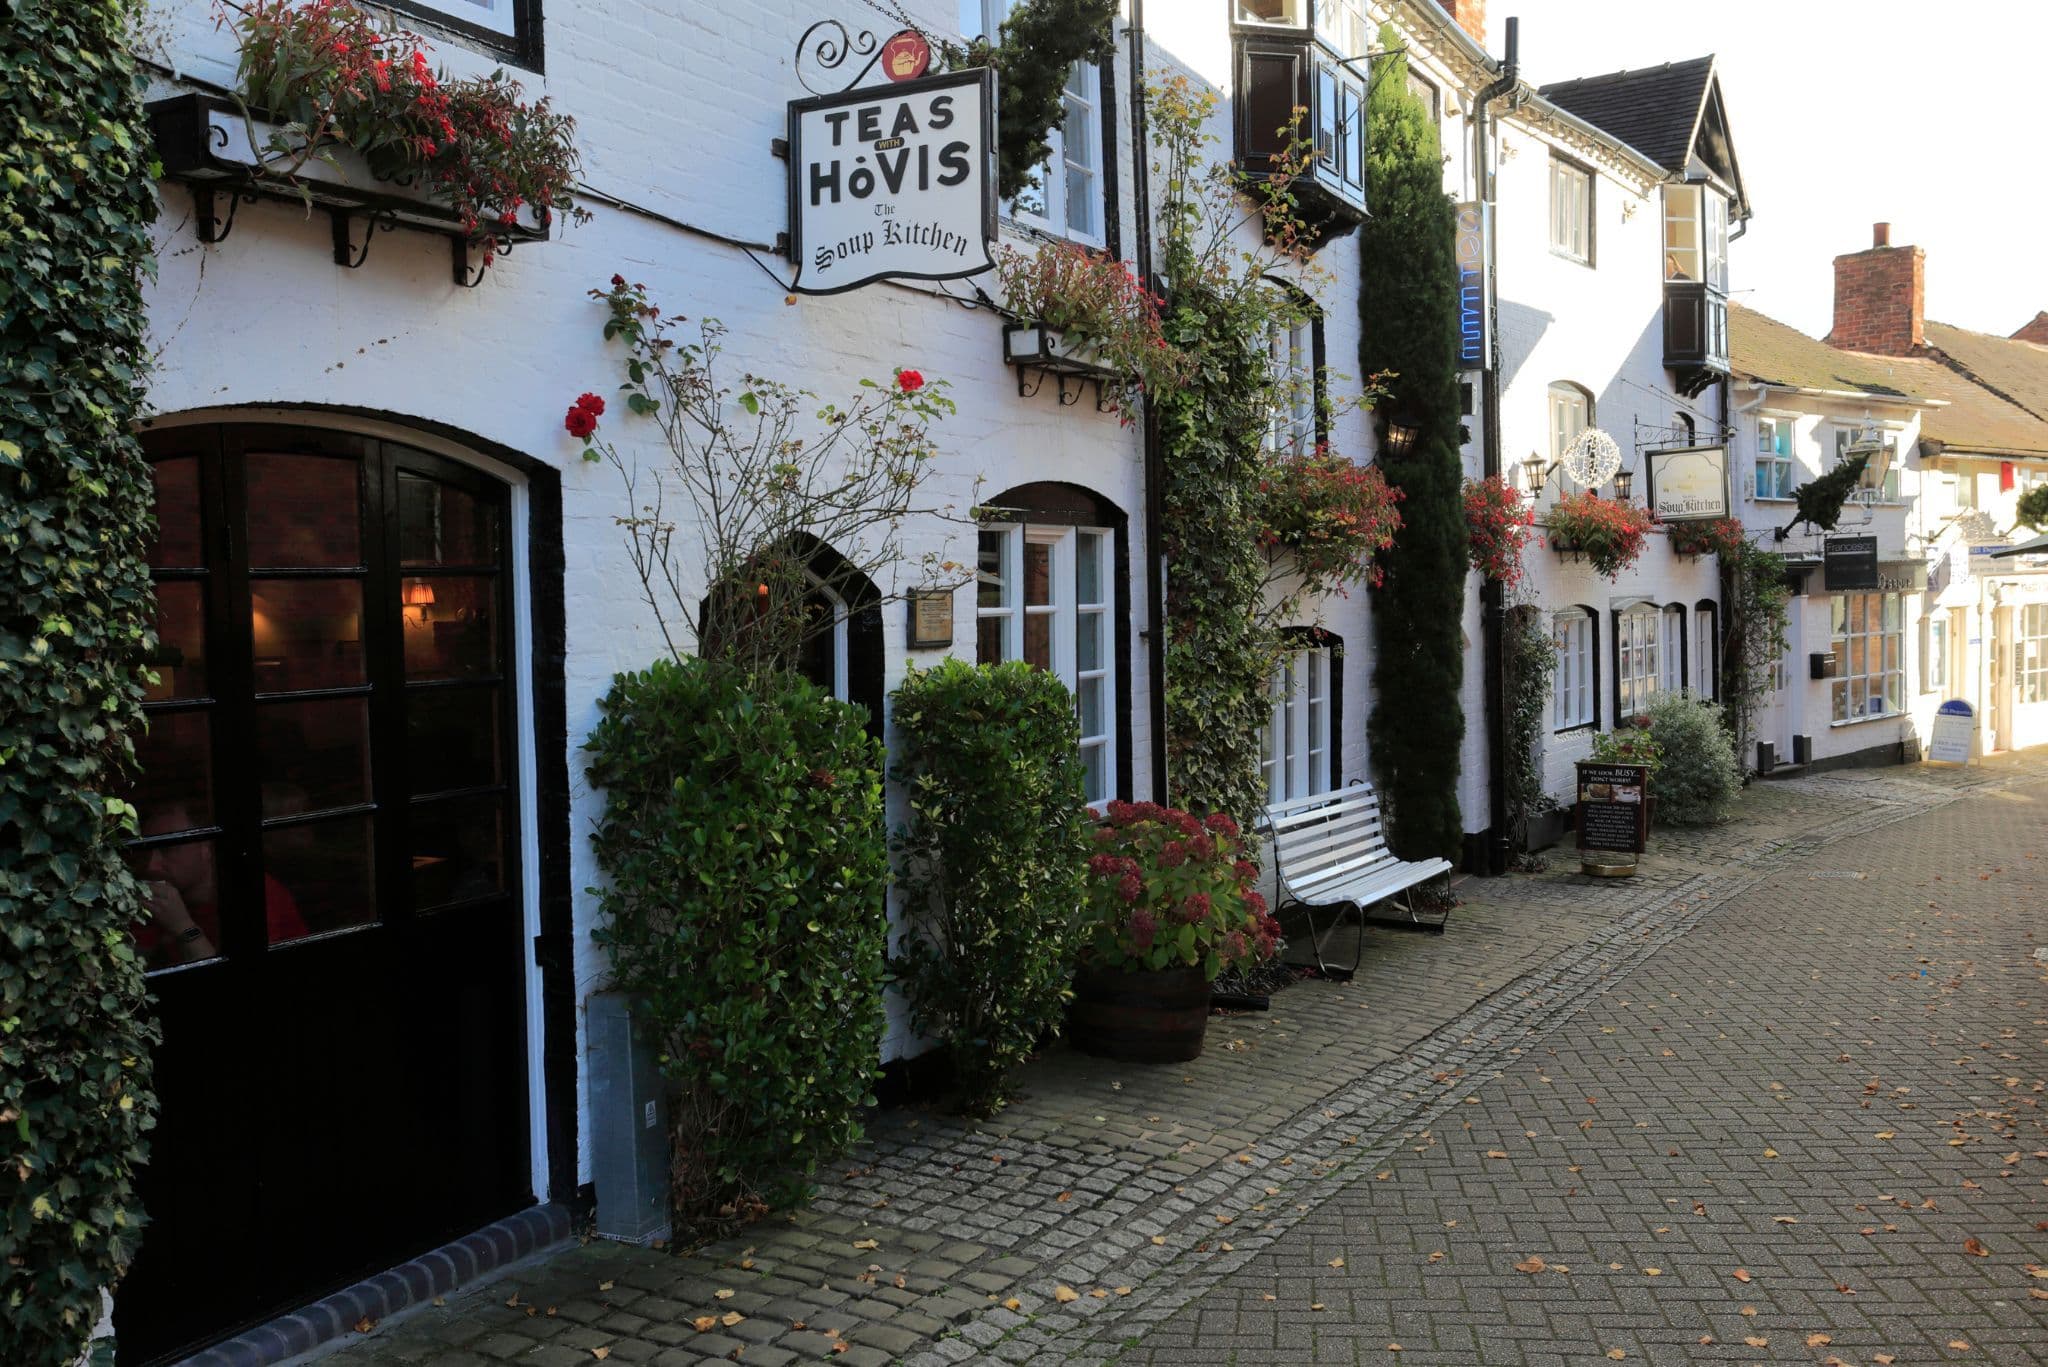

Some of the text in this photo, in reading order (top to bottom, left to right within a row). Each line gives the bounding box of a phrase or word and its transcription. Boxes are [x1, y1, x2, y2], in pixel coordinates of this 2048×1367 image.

[825, 96, 954, 146] TEAS
[878, 138, 901, 149] WITH
[874, 203, 896, 216] The
[815, 219, 969, 274] Soup Kitchen
[1659, 499, 1721, 514] Soup Kitchen
